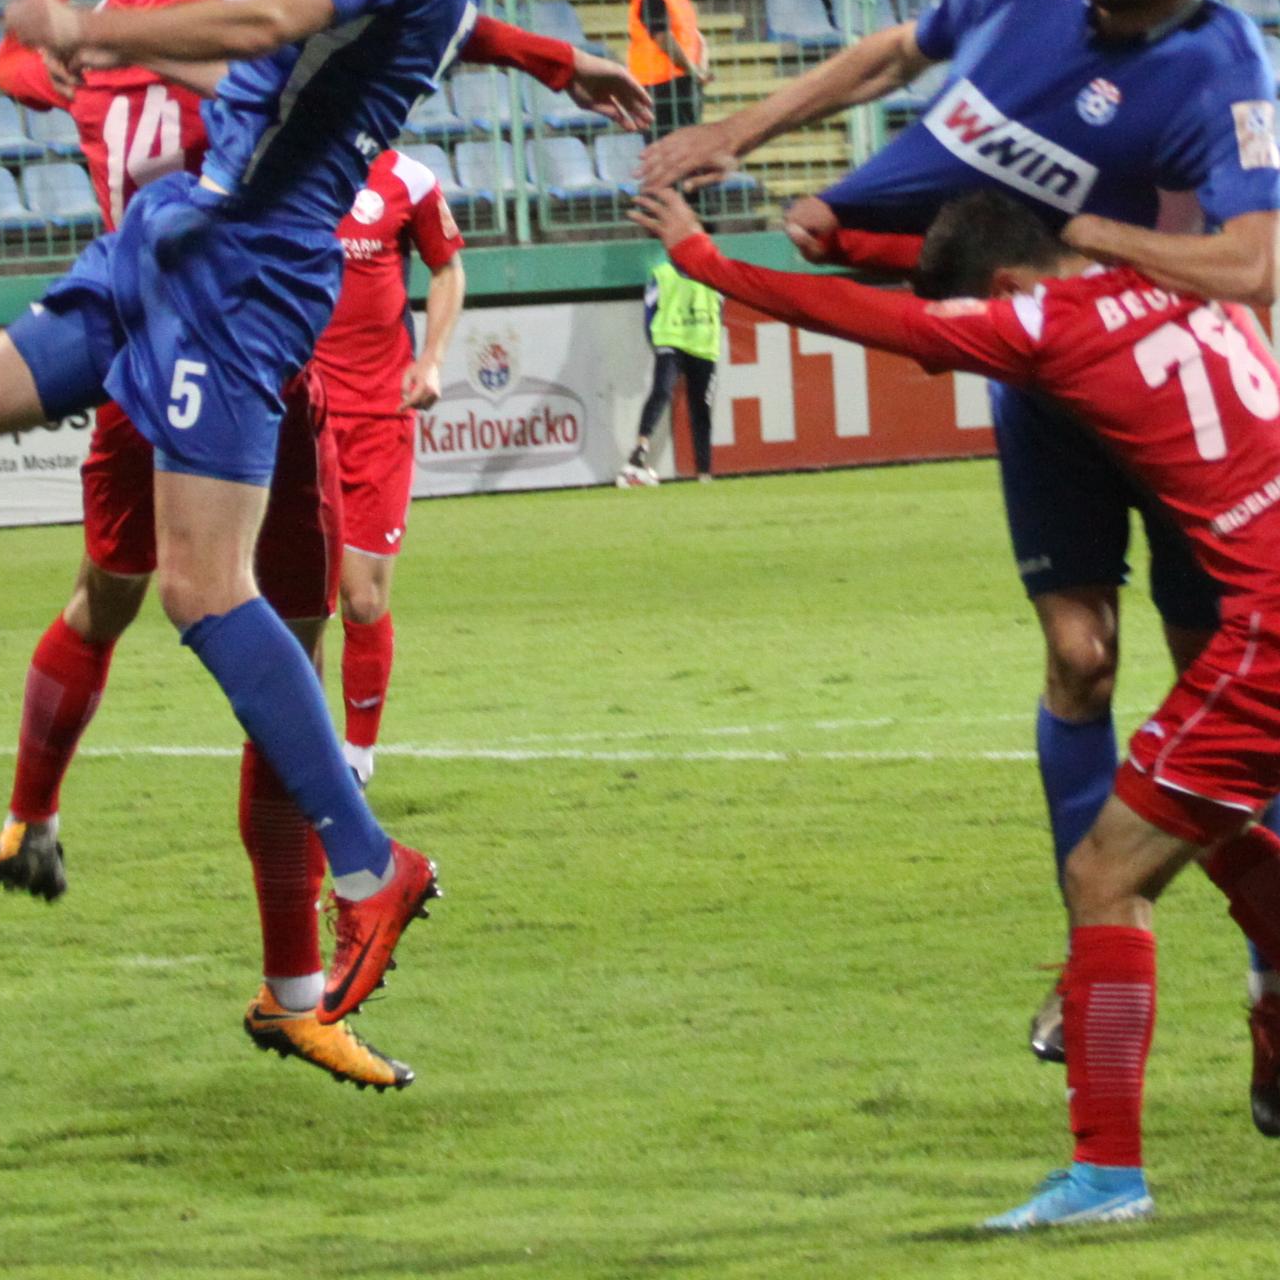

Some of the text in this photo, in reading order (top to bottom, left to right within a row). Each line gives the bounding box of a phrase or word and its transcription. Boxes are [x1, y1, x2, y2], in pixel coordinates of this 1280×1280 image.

[103, 84, 186, 227] 14
[167, 359, 208, 429] 5
[710, 322, 870, 446] HT
[23, 454, 78, 471] Mostar
